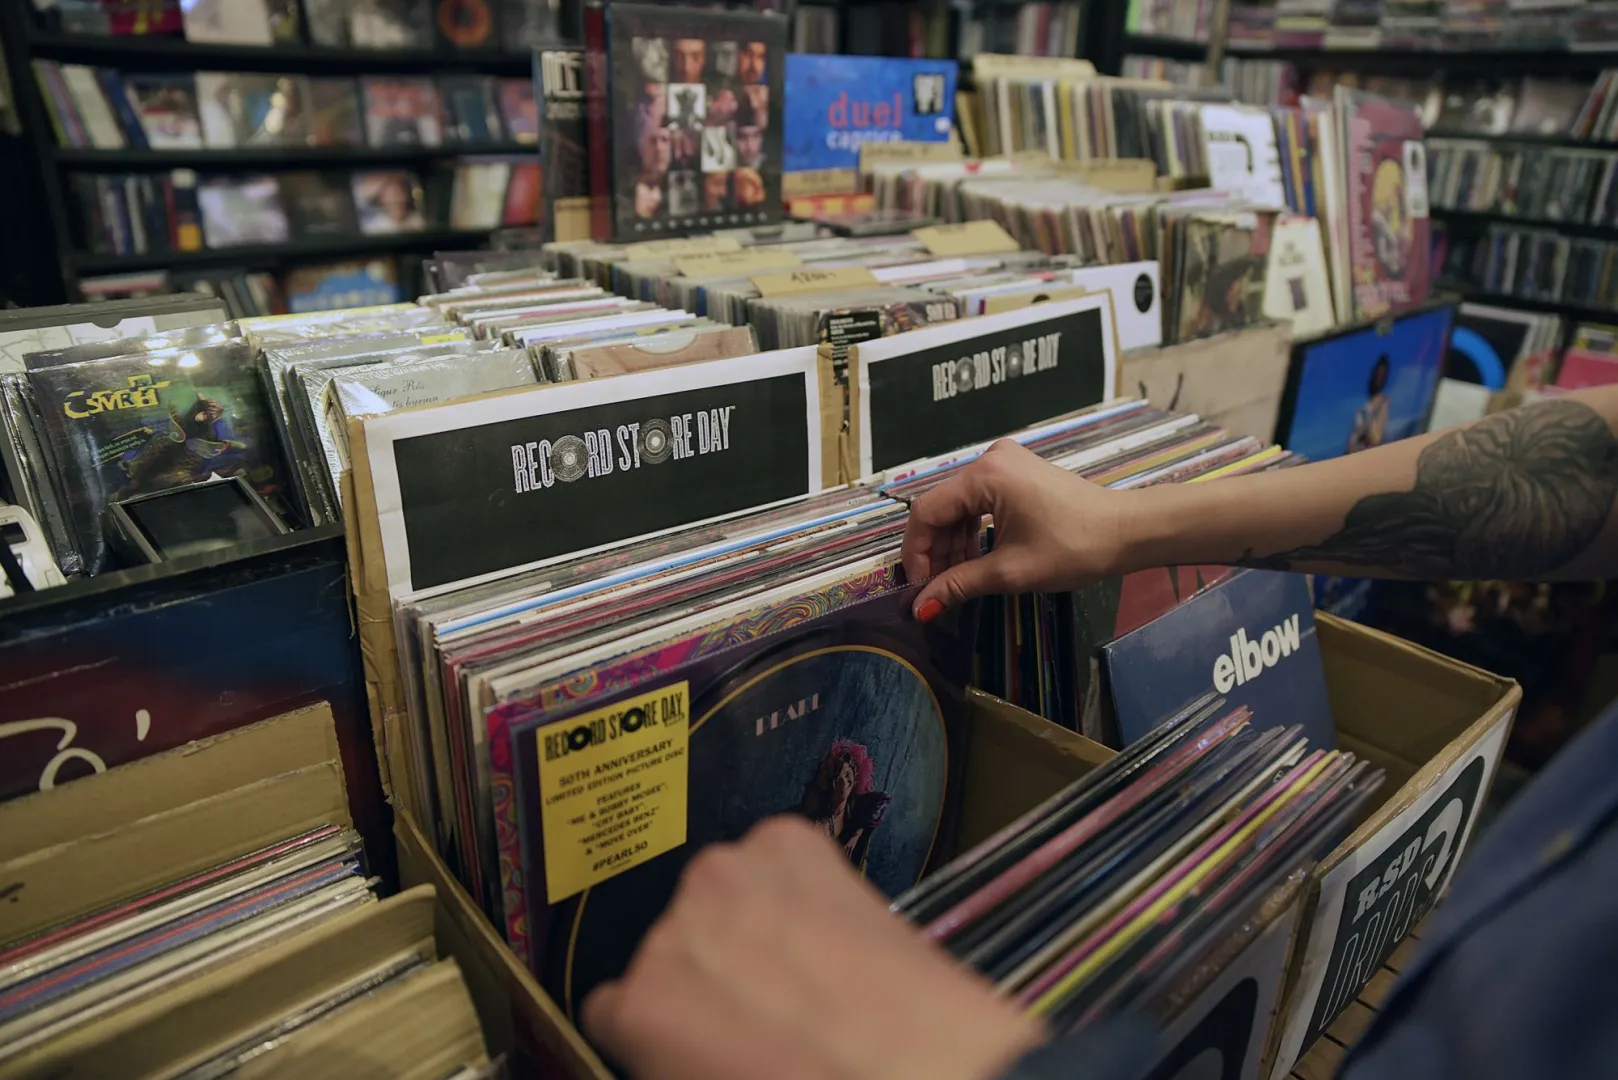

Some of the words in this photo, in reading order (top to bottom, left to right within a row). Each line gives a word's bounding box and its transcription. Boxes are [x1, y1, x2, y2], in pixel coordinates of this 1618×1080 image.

[828, 90, 903, 128] duel
[932, 352, 991, 402] RECORD
[991, 338, 1037, 385] STORE
[511, 429, 614, 494] RECORD
[616, 413, 695, 472] STORE
[1213, 613, 1300, 694] elbow
[545, 719, 607, 762] RECORD
[609, 700, 658, 741] STORE
[661, 692, 683, 722] DAY
[545, 786, 585, 806] LIMITED
[626, 757, 662, 776] PICTURE
[594, 738, 674, 775] ANNIVERSARY
[596, 782, 642, 805] FEATURES
[592, 841, 649, 872] #PEARL50
[1352, 836, 1423, 925] RSD
